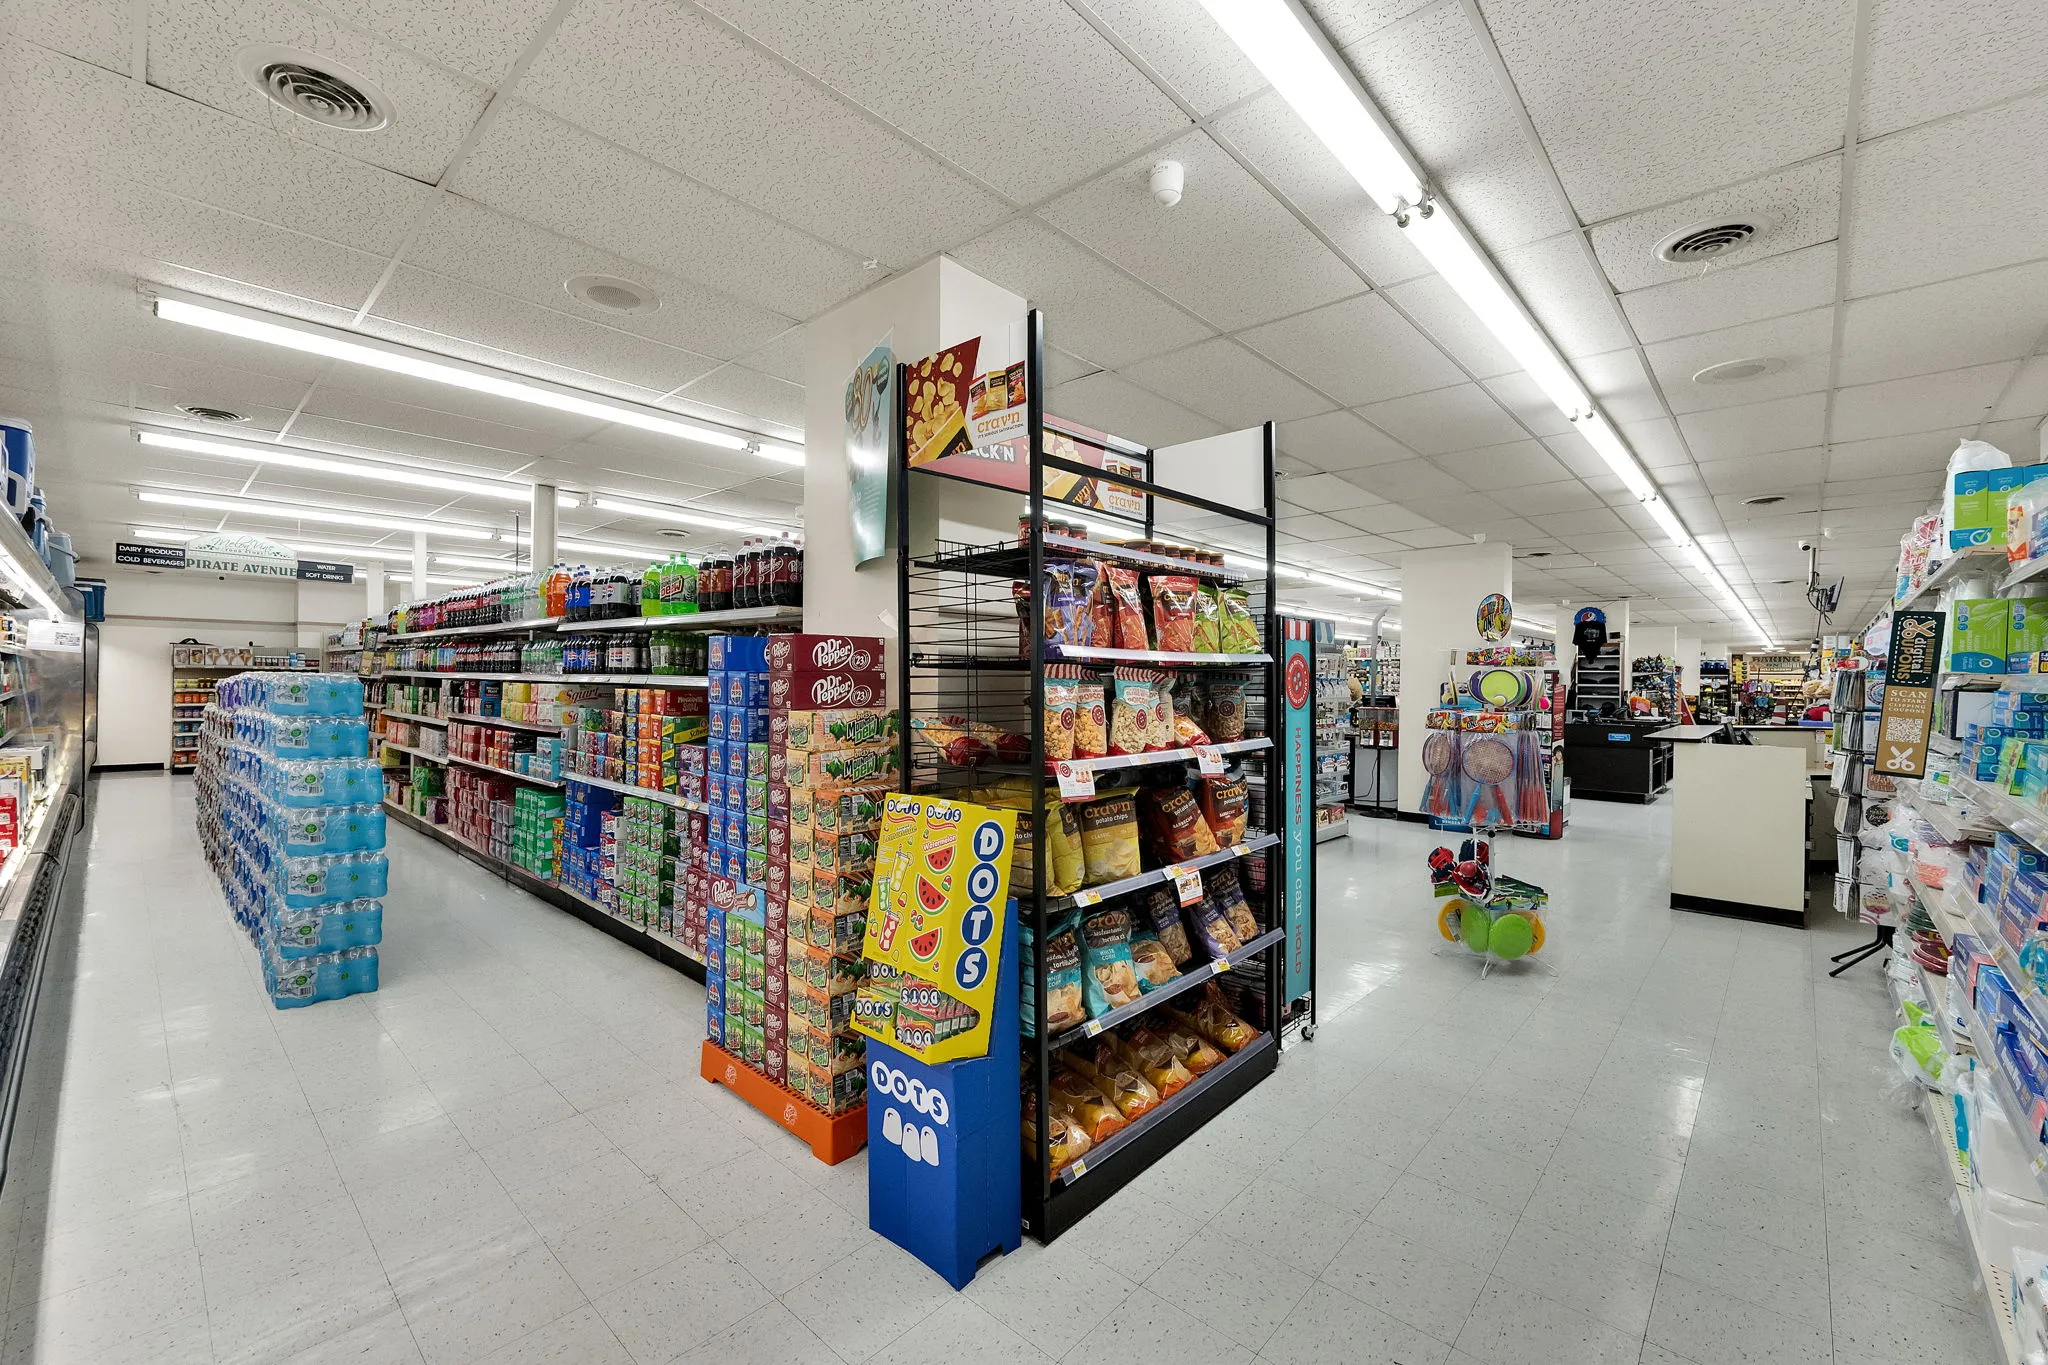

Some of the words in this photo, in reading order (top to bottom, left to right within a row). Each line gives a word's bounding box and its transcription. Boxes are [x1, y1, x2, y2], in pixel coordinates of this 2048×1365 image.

[977, 411, 1020, 433] crav'n
[119, 545, 142, 553] DAIRY
[144, 547, 184, 557] PRODUCTS
[117, 555, 141, 563] COLD
[142, 557, 185, 567] BEVERAGES
[186, 558, 239, 572] PIRATE
[242, 563, 297, 577] AVENUE
[322, 573, 344, 581] DRINKS
[827, 638, 842, 652] Dr
[817, 641, 851, 667] Pepper
[855, 655, 864, 666] 23
[1911, 637, 1927, 674] digital
[827, 675, 842, 686] Dr
[566, 687, 599, 704] Squirt
[816, 679, 851, 705] Pepper
[856, 692, 865, 701] 23
[1890, 689, 1928, 699] SCAN
[1888, 702, 1926, 710] CLIPPING
[1294, 727, 1302, 824] HAPPINESS
[1084, 800, 1132, 819] crav'n
[1095, 815, 1113, 826] potato
[1113, 813, 1129, 823] chips
[922, 834, 957, 852] Watermelon
[1293, 829, 1303, 873] you
[714, 881, 734, 904] Pepper
[1295, 877, 1303, 919] can
[960, 825, 1000, 985] DOTS
[1101, 934, 1120, 944] tortilla
[1100, 948, 1115, 957] WHITE
[1101, 954, 1117, 962] CORN
[901, 987, 941, 1007] DOTS
[855, 1000, 893, 1017] DOTS
[874, 1063, 946, 1121] DOTS
